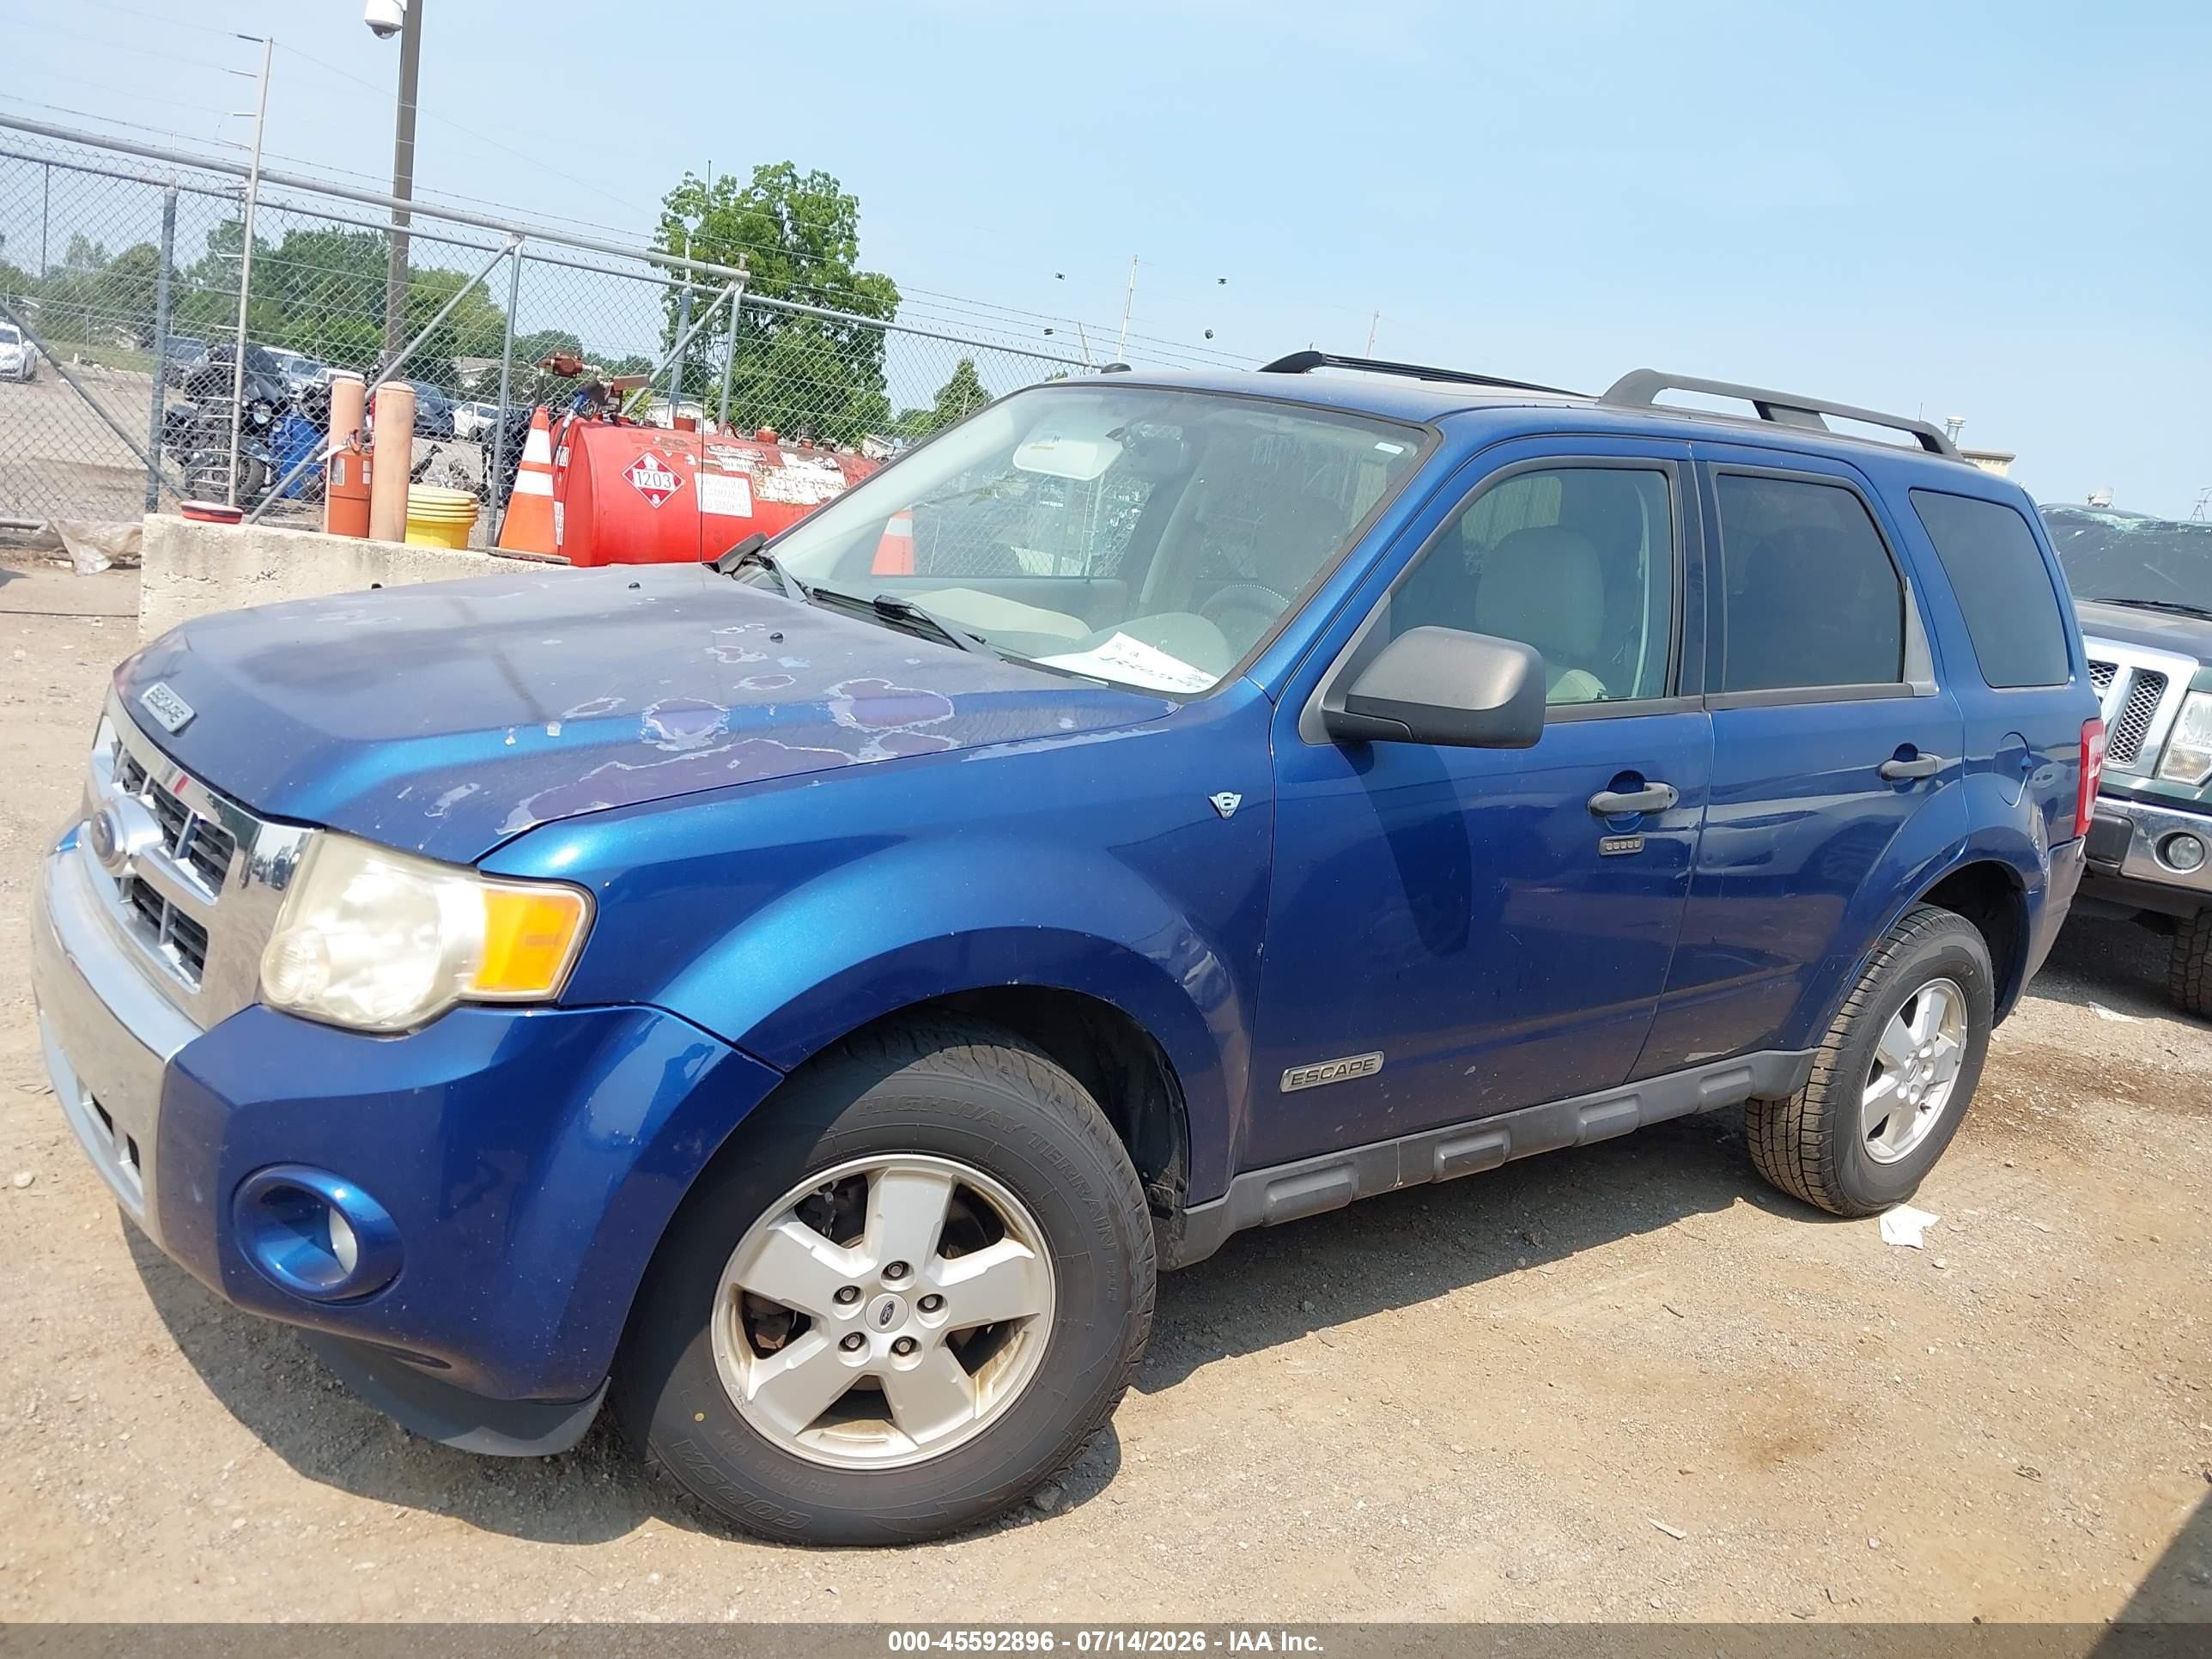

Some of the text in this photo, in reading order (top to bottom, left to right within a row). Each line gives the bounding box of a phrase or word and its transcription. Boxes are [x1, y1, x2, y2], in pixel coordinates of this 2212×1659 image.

[636, 471, 672, 489] 1203
[1291, 1057, 1376, 1086] ESCAPE
[856, 1094, 1027, 1134] HIGHWAY
[1027, 1130, 1119, 1251] TERRAIN
[670, 1437, 813, 1532] CORSA
